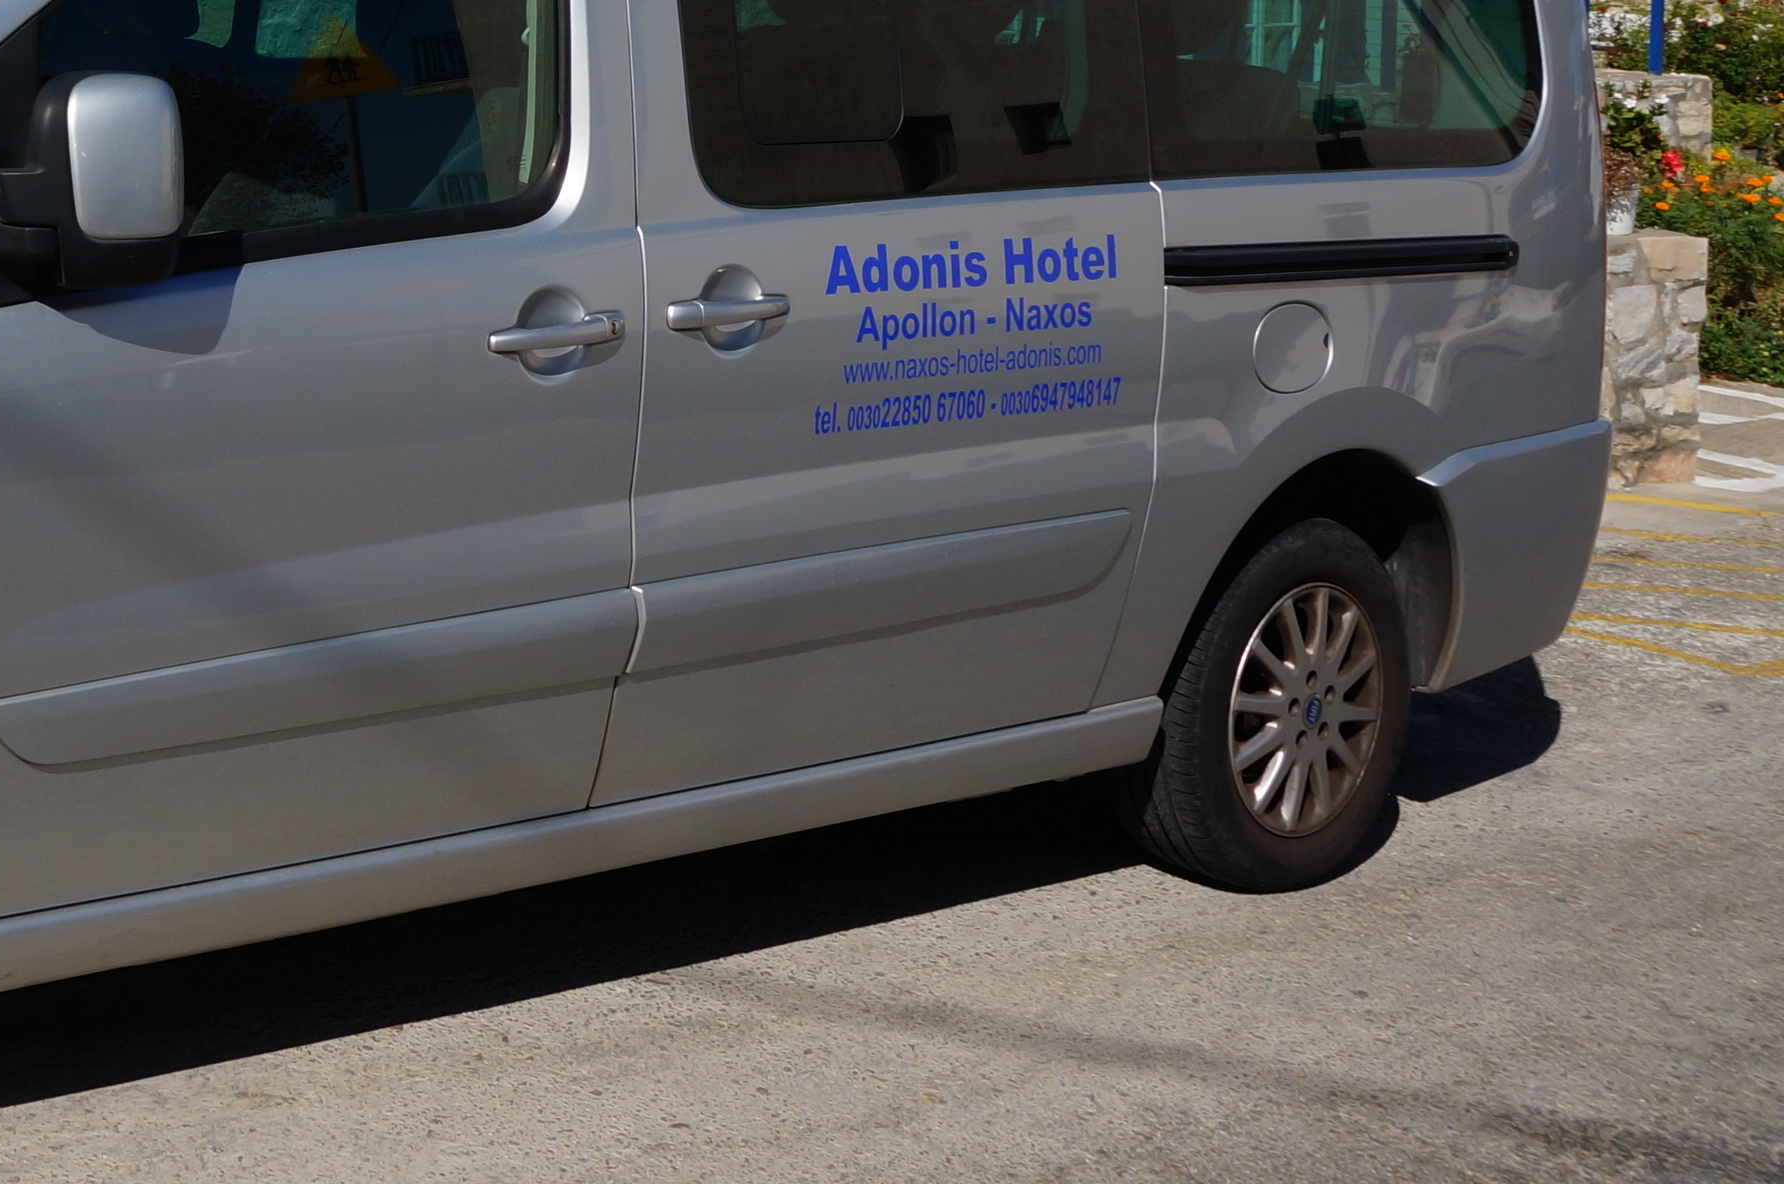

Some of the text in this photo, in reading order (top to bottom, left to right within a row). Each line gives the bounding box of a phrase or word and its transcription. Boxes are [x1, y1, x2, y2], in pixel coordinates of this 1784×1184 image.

[825, 234, 1117, 295] Adonis Hotel
[856, 302, 976, 351] Apollon
[1005, 297, 1093, 332] Naxos
[844, 341, 1103, 384] www.naxos-hotel-adonis.com
[814, 402, 841, 435] tel.
[847, 393, 932, 432] 003022850
[937, 389, 986, 422] 67060
[1000, 377, 1122, 416] 00306947948147
